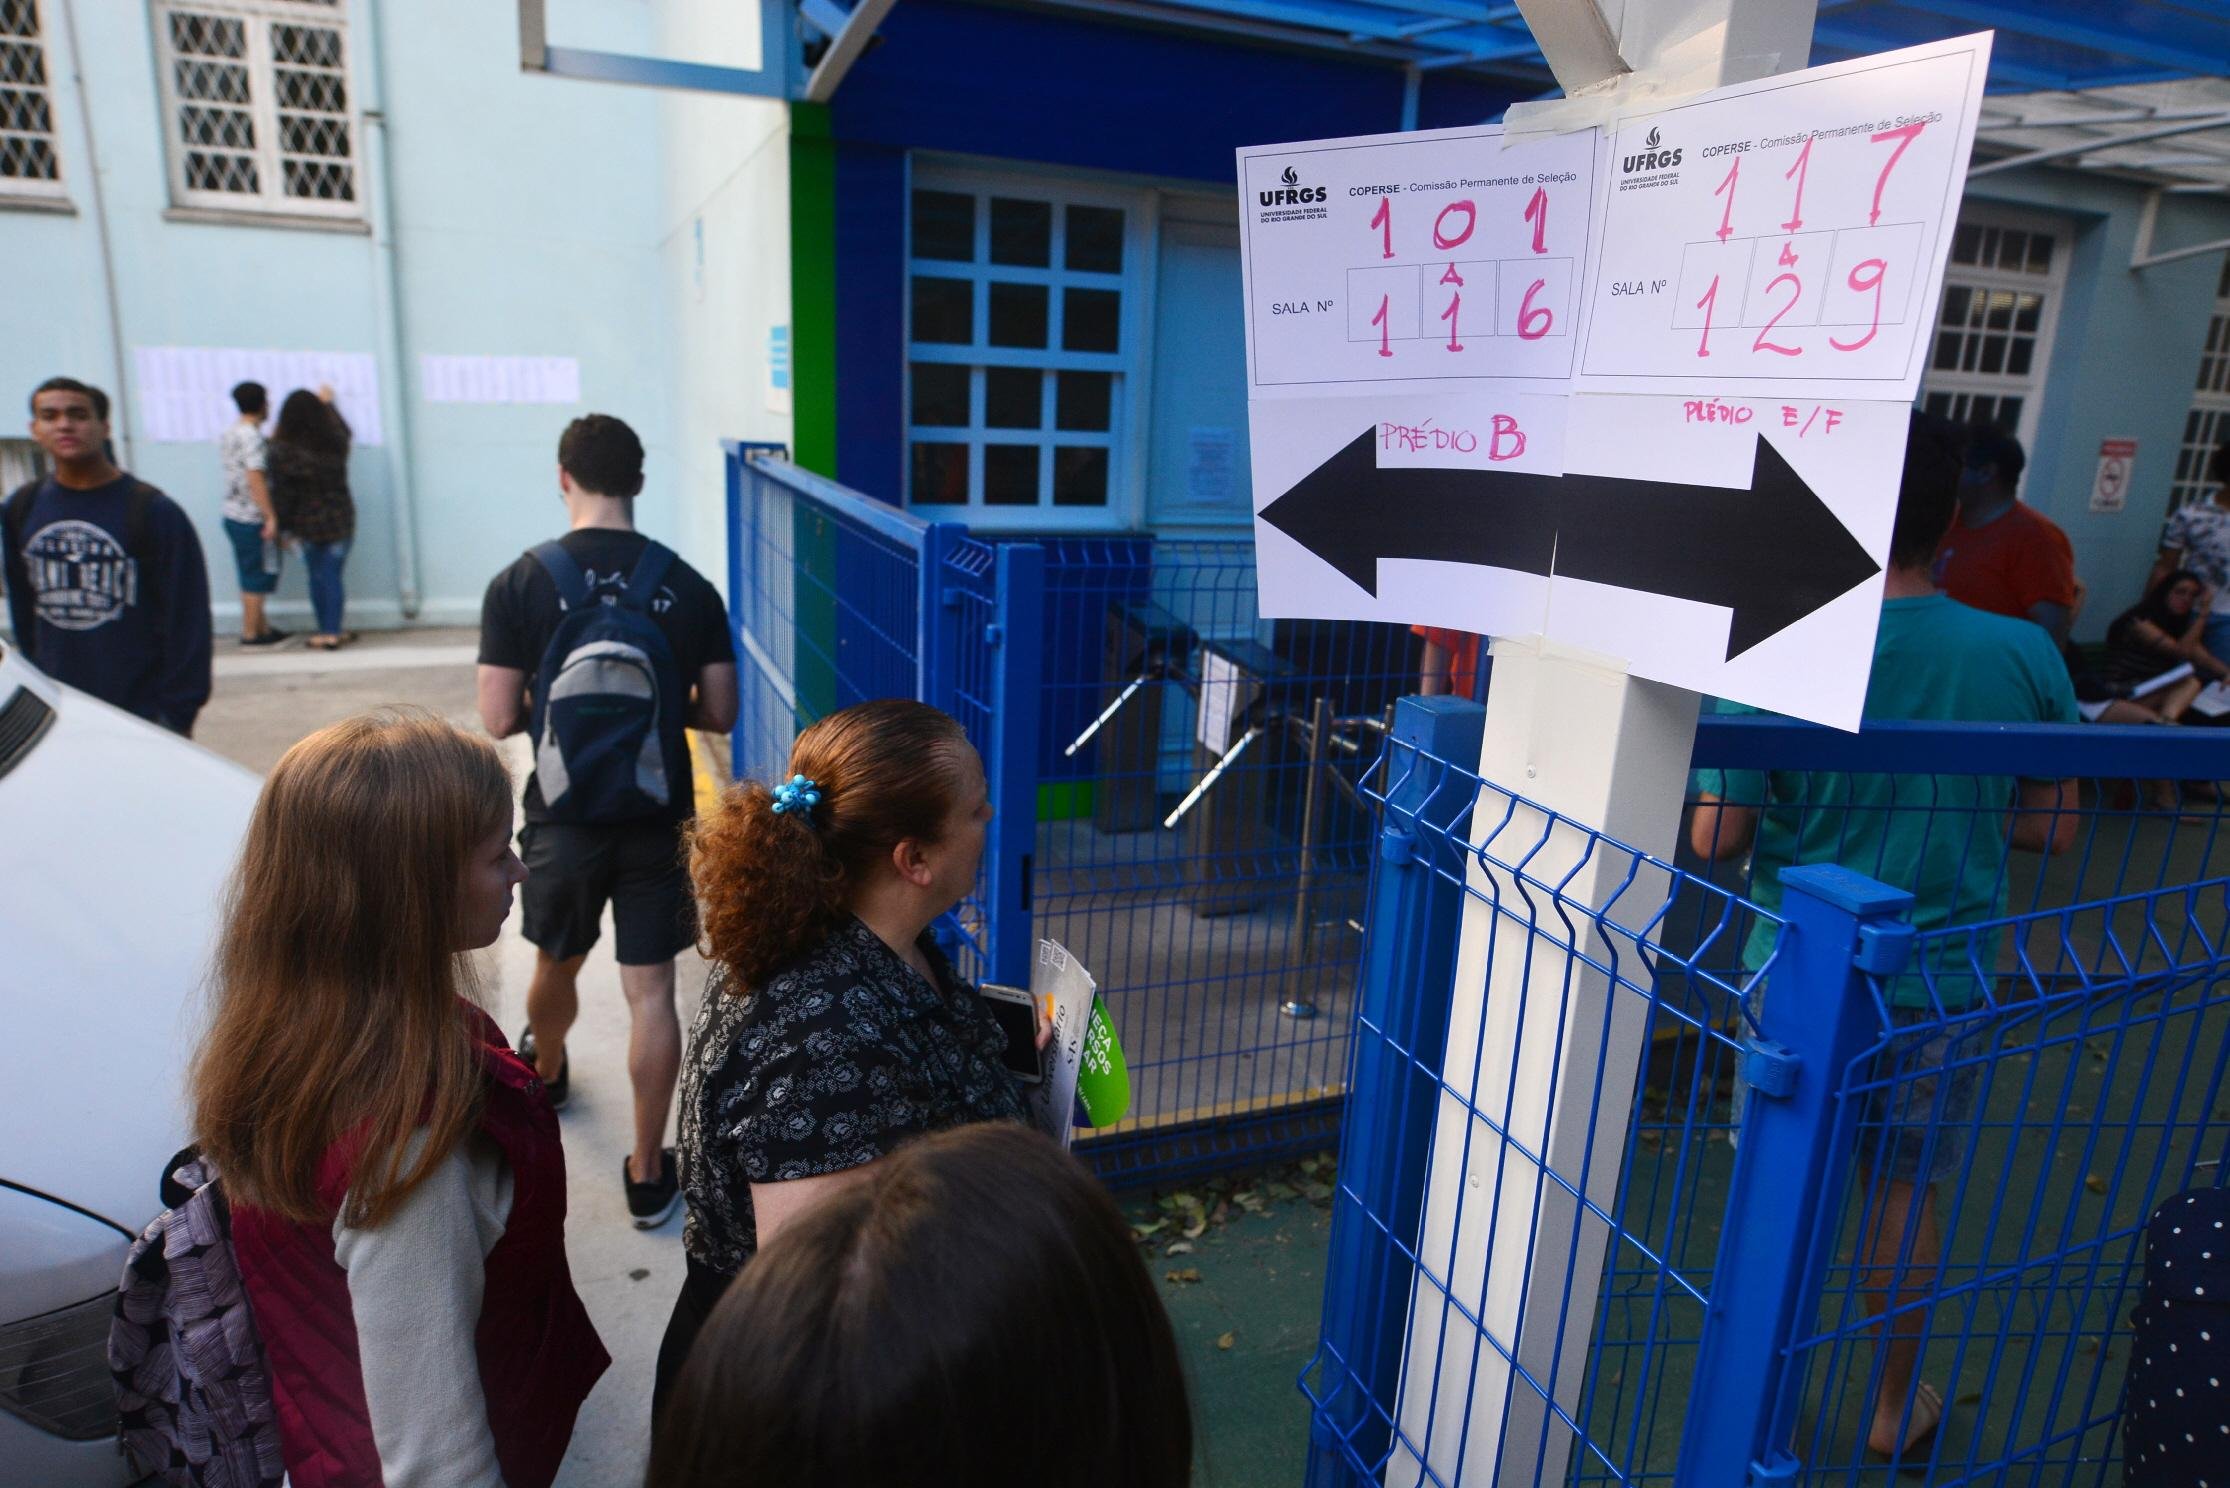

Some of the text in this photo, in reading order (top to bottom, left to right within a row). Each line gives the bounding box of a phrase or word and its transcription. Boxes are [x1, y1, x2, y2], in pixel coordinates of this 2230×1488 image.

[1702, 140, 1751, 158] COPERSE
[1760, 131, 1808, 150] Comissão
[1811, 121, 1874, 141] Permanente
[1877, 117, 1891, 130] de
[1623, 148, 1683, 173] UFRGS
[1349, 184, 1401, 197] COPERSE
[1409, 179, 1458, 193] Comissão
[1460, 176, 1520, 190] Permanente
[1521, 174, 1535, 184] de
[1536, 171, 1577, 185] Seleção
[1260, 186, 1327, 207] UFRGS
[1260, 209, 1303, 218] UNIVERSIDADE
[1282, 214, 1306, 222] GRANDE
[1611, 282, 1644, 297] SALA
[1271, 302, 1311, 316] SALA
[1380, 414, 1527, 461] PRÉDIO B
